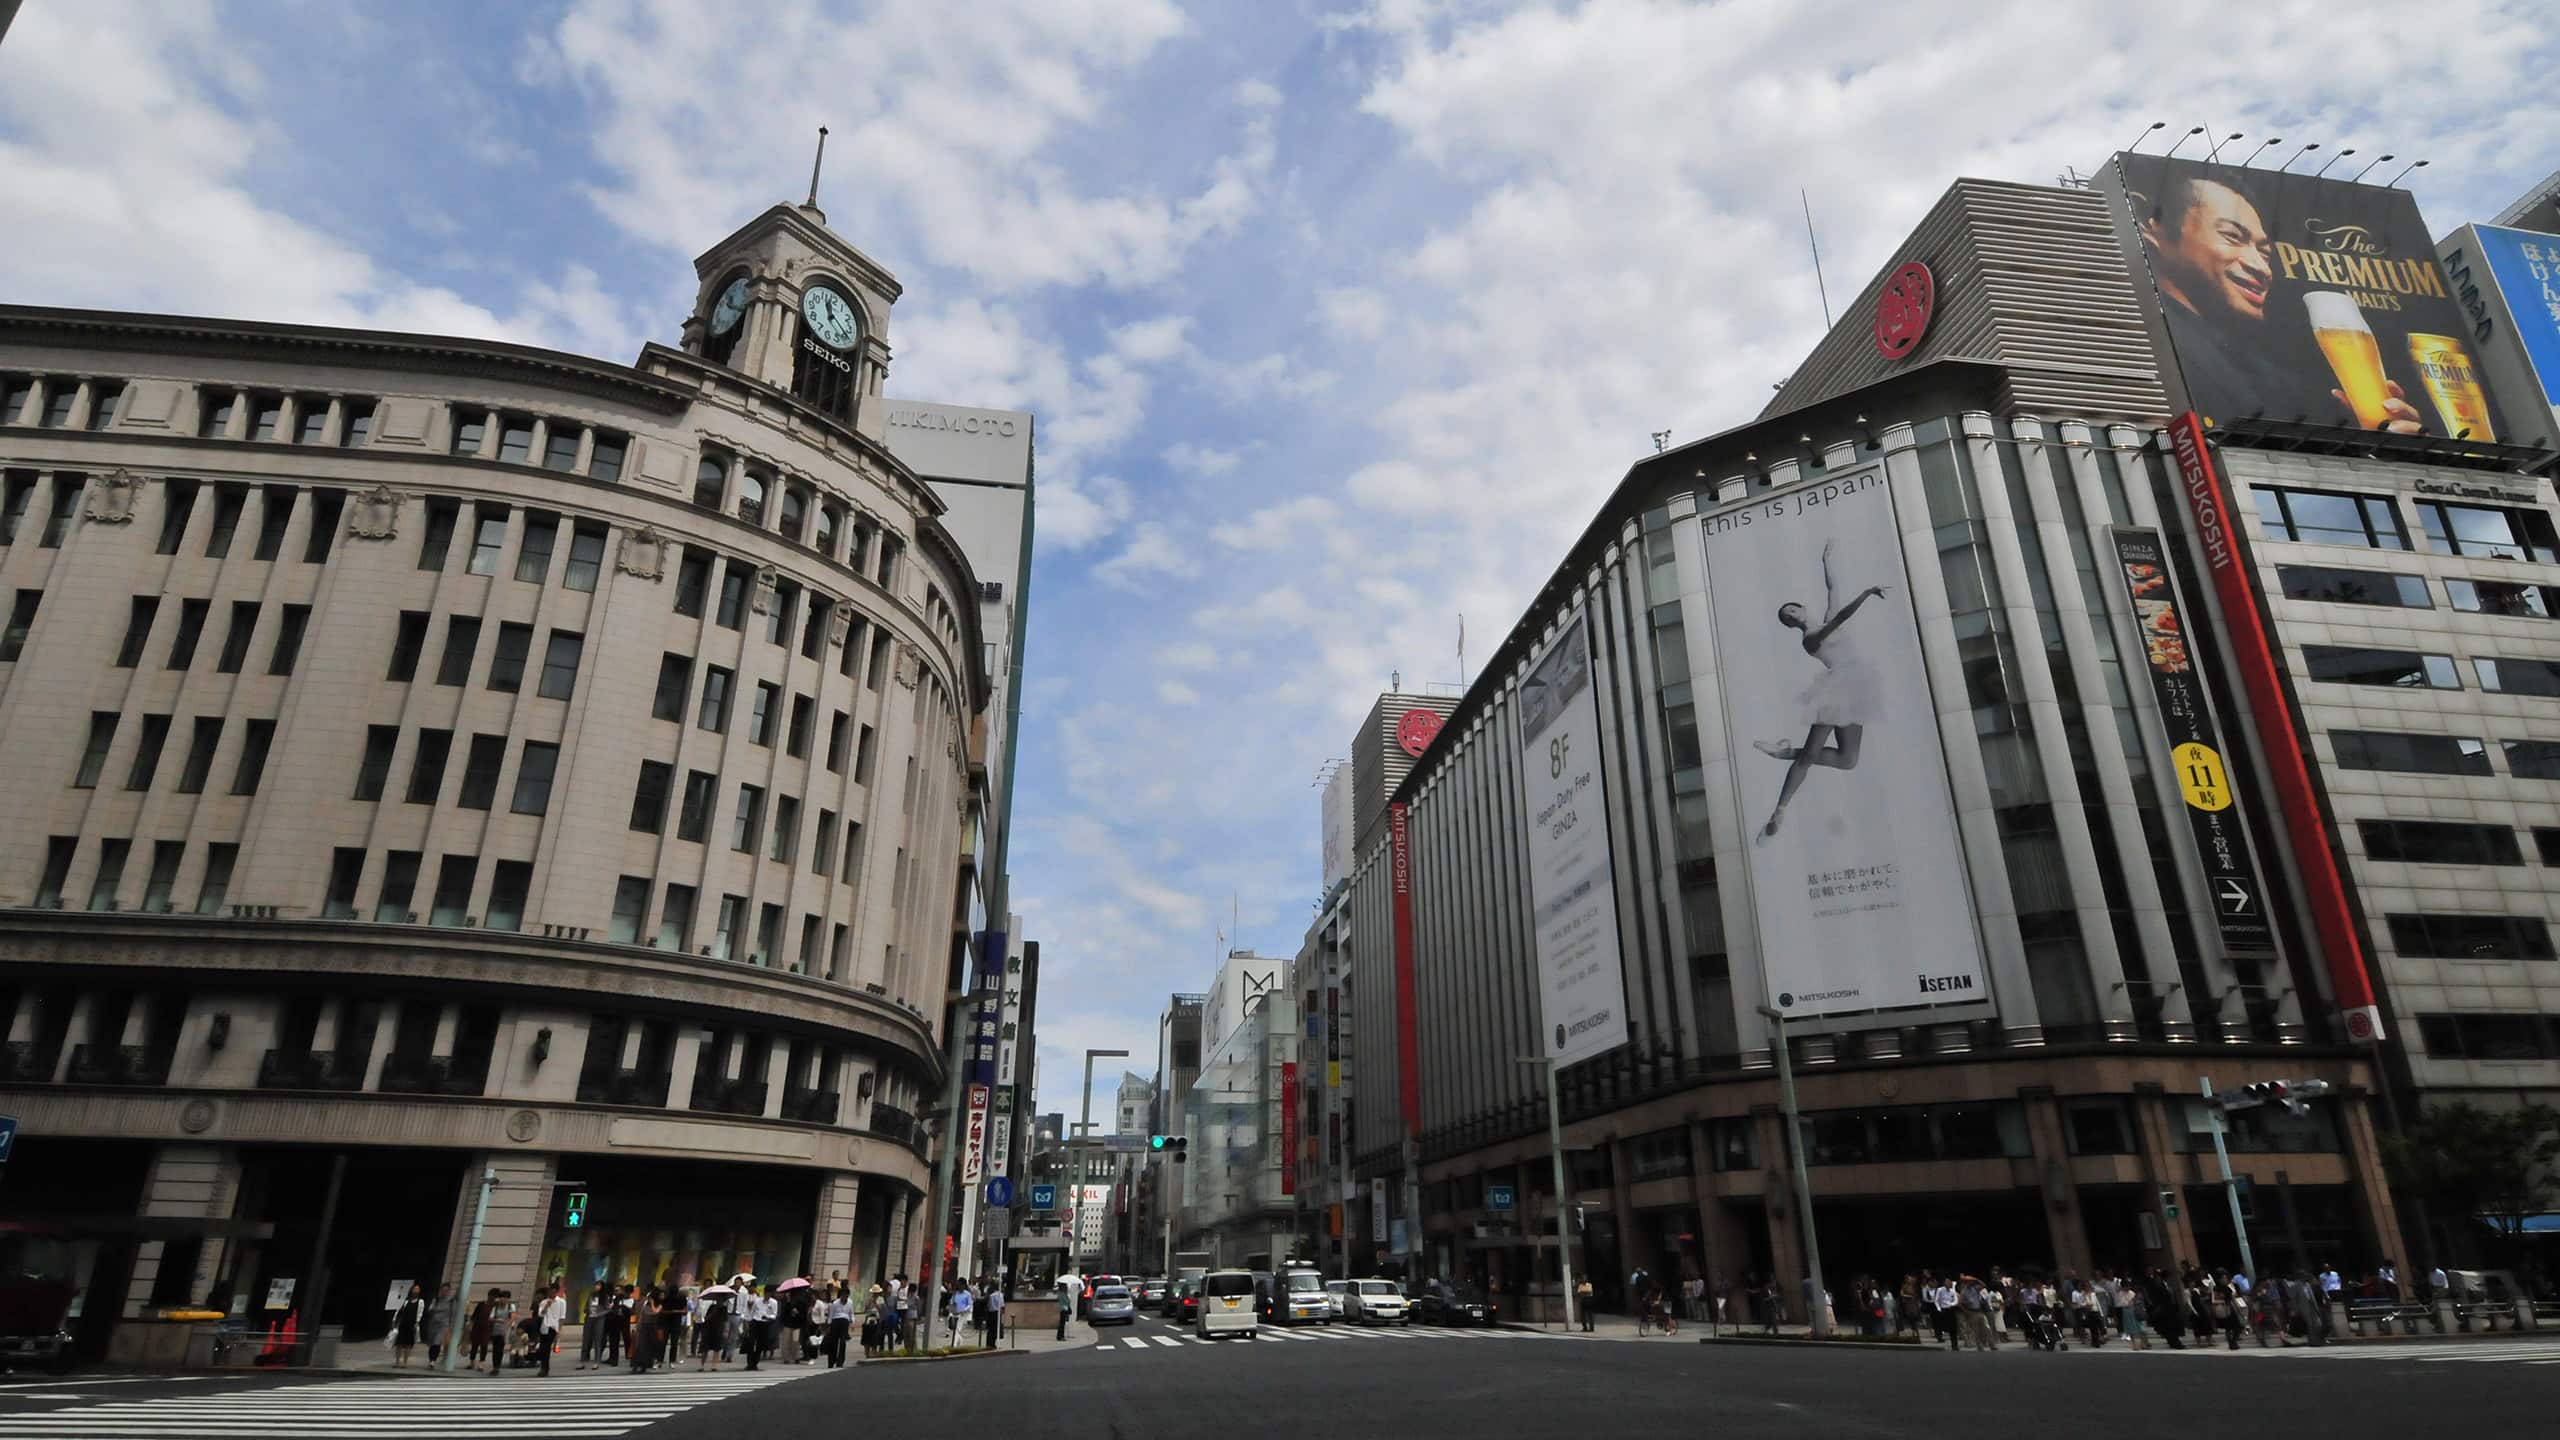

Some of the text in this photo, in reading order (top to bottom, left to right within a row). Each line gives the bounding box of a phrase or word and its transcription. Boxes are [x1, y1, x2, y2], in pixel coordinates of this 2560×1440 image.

[2304, 218, 2386, 256] The
[2275, 241, 2447, 299] PREMIUM
[804, 338, 851, 373] SEIKO
[1704, 472, 1884, 536] this is japan.
[2176, 425, 2230, 569] MITSUKOSHI
[2120, 543, 2153, 552] GINZA
[2122, 551, 2157, 561] DINING
[1551, 733, 1570, 780] 8F
[1575, 772, 1591, 792] Free
[2187, 764, 2216, 788] 11
[1552, 810, 1578, 840] GINZA
[1394, 809, 1407, 893] MITSUKOSHI
[1798, 988, 1860, 1002] MITSUKOSHI
[1568, 1008, 1610, 1038] MITSUKOSHI
